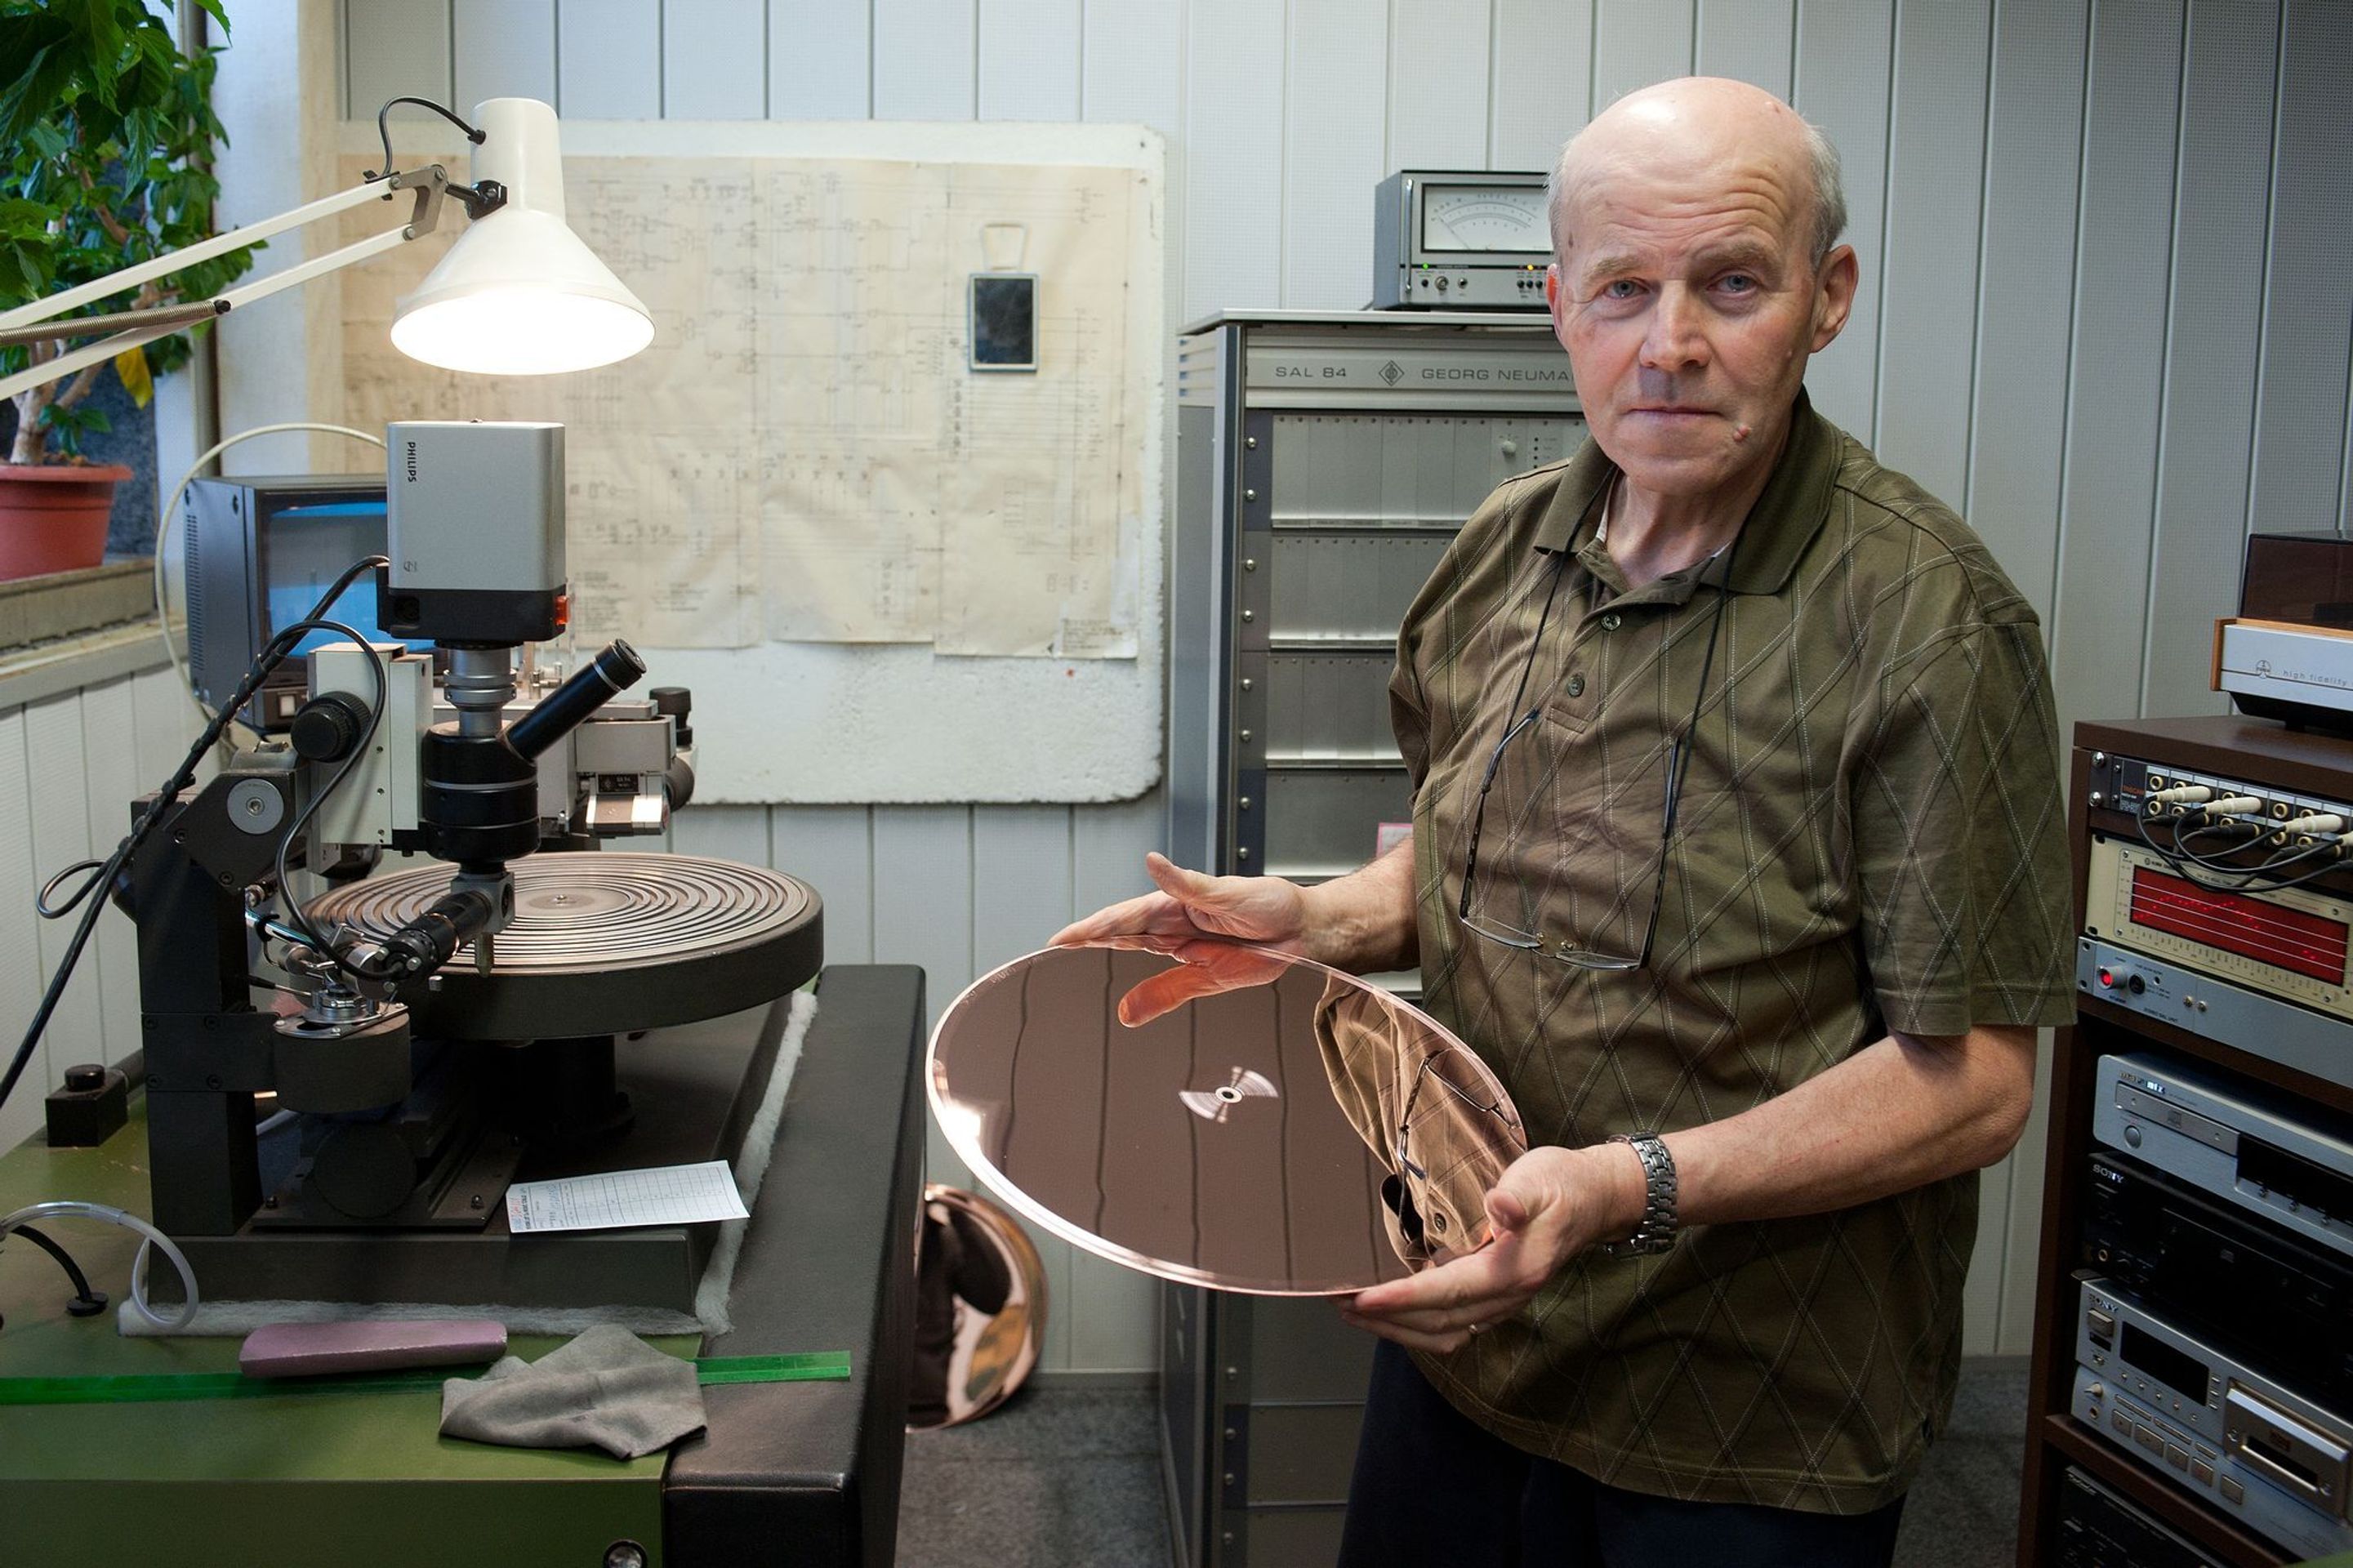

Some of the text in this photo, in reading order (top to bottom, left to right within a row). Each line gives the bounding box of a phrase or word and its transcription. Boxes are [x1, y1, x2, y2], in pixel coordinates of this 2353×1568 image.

[1275, 367, 1347, 378] SAL 84
[1421, 368, 1574, 381] GEORG NEUMA
[408, 442, 417, 483] PHILIPS
[2283, 670, 2348, 687] high fidelity
[2092, 1164, 2124, 1183] SONY
[2089, 1294, 2119, 1312] SONY
